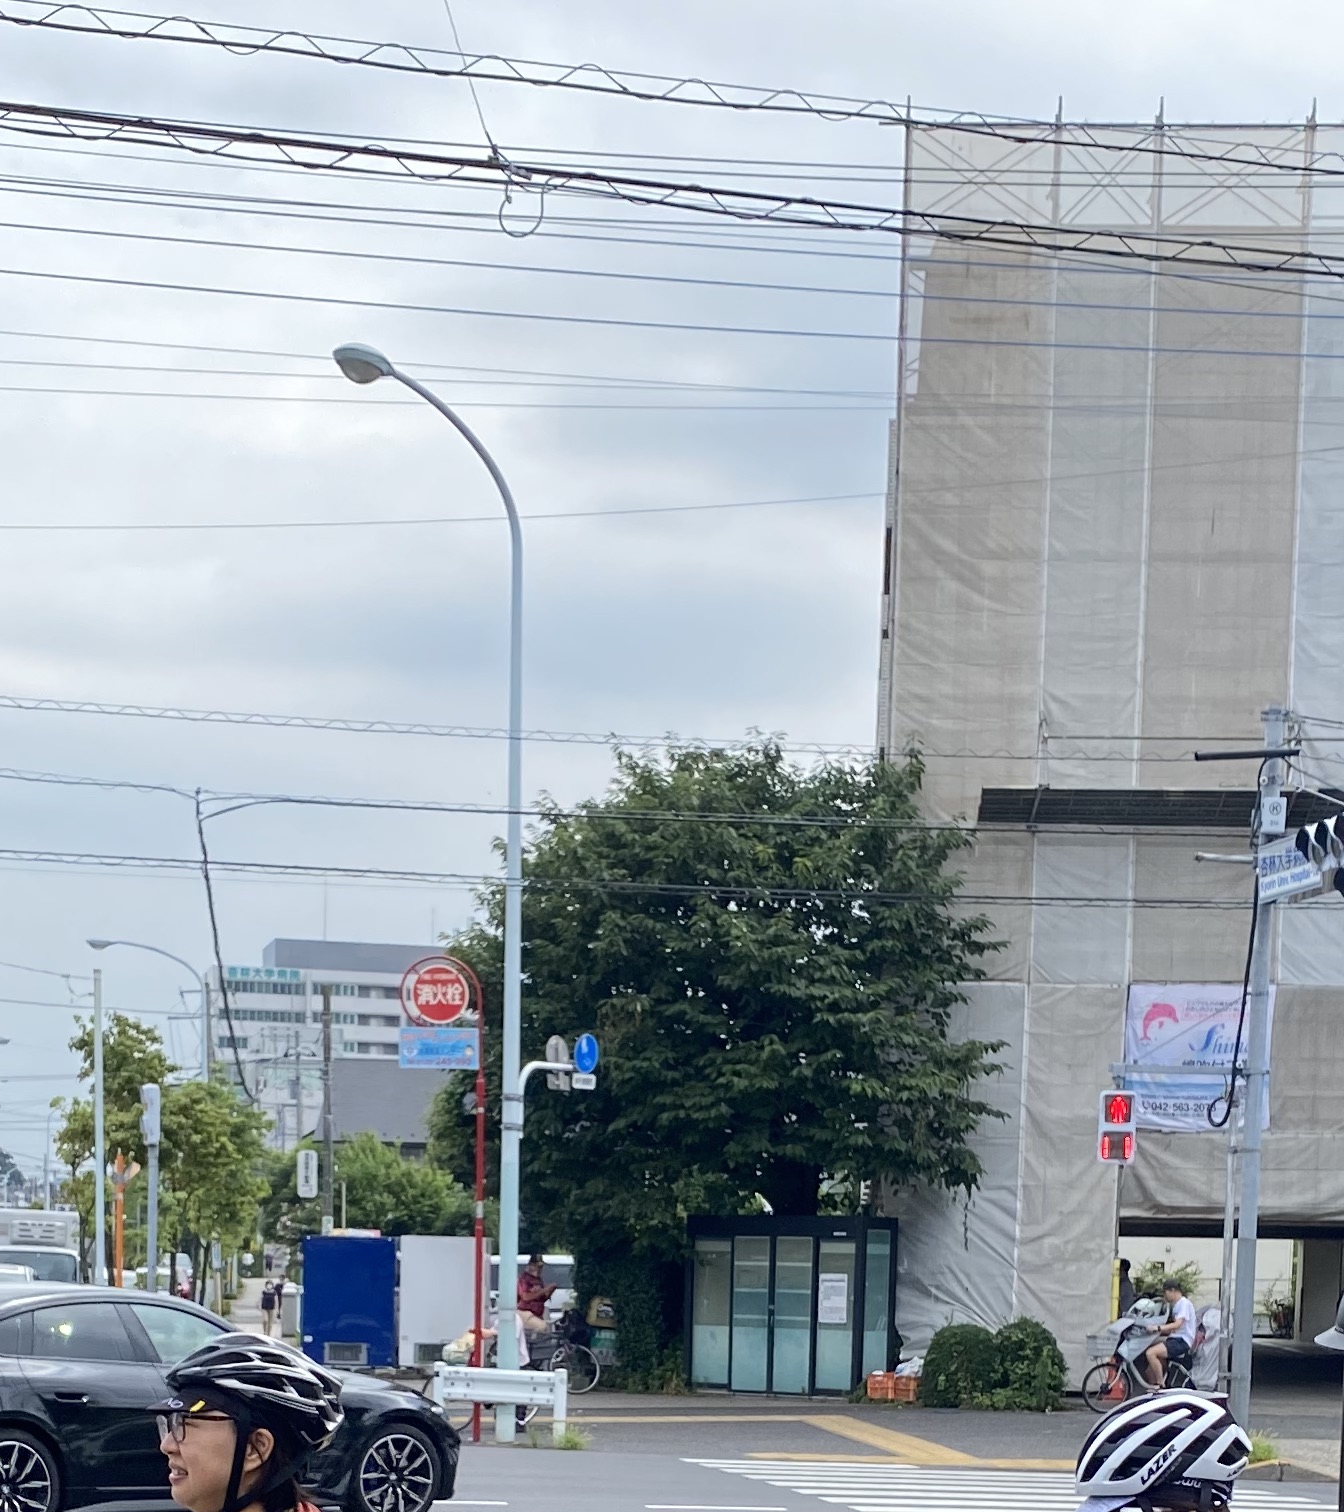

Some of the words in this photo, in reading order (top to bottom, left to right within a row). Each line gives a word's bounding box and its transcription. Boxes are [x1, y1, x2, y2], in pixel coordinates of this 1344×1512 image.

[416, 983, 463, 1005] 消火栓
[1140, 1443, 1178, 1486] LAZER
